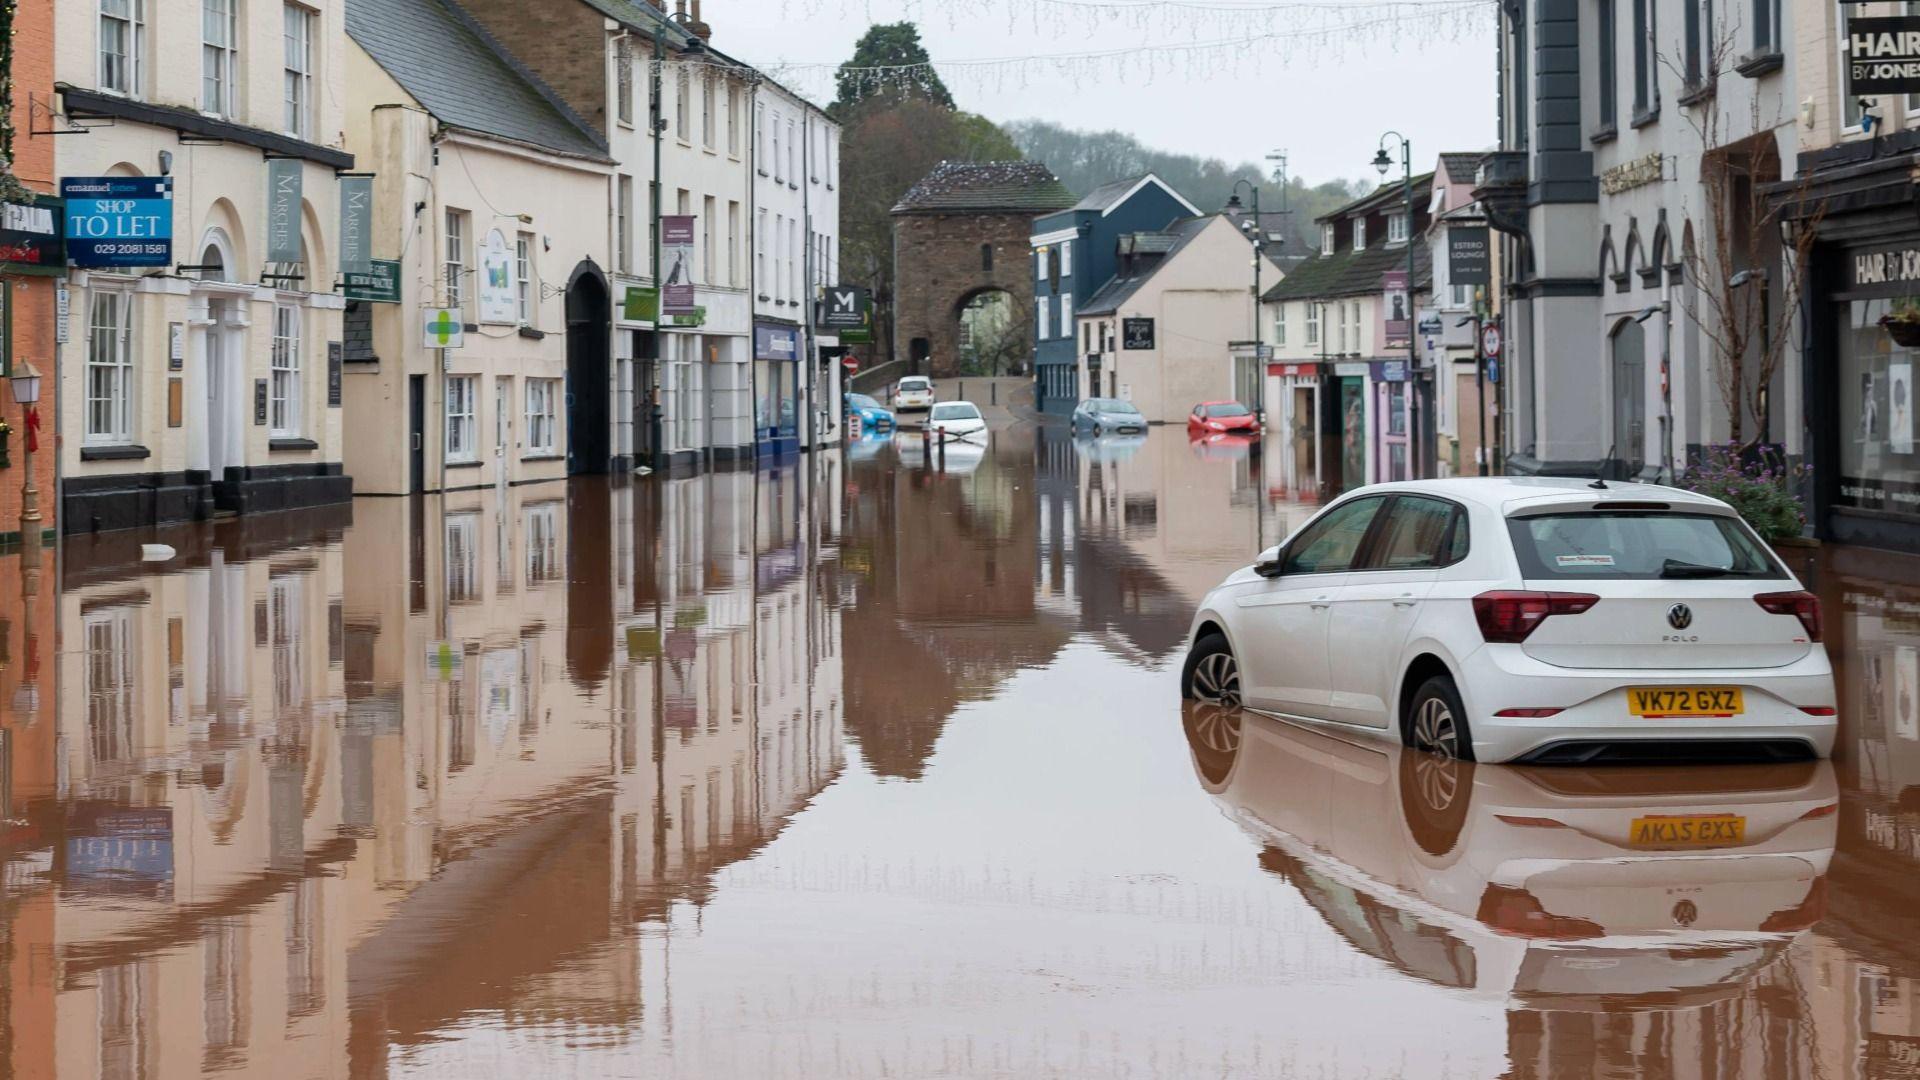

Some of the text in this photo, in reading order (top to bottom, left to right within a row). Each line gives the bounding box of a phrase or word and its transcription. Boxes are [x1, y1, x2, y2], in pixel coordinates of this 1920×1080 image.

[1851, 31, 1920, 57] HAIR
[1852, 65, 1870, 79] BY
[95, 200, 136, 214] SHOP
[70, 215, 161, 237] TO LET
[94, 244, 167, 254] 029 2081 1581
[1454, 241, 1483, 249] ESTERO
[1451, 251, 1485, 259] LOUNGE
[1856, 253, 1886, 284] HAIR
[1636, 690, 1737, 711] VK72 GXZ
